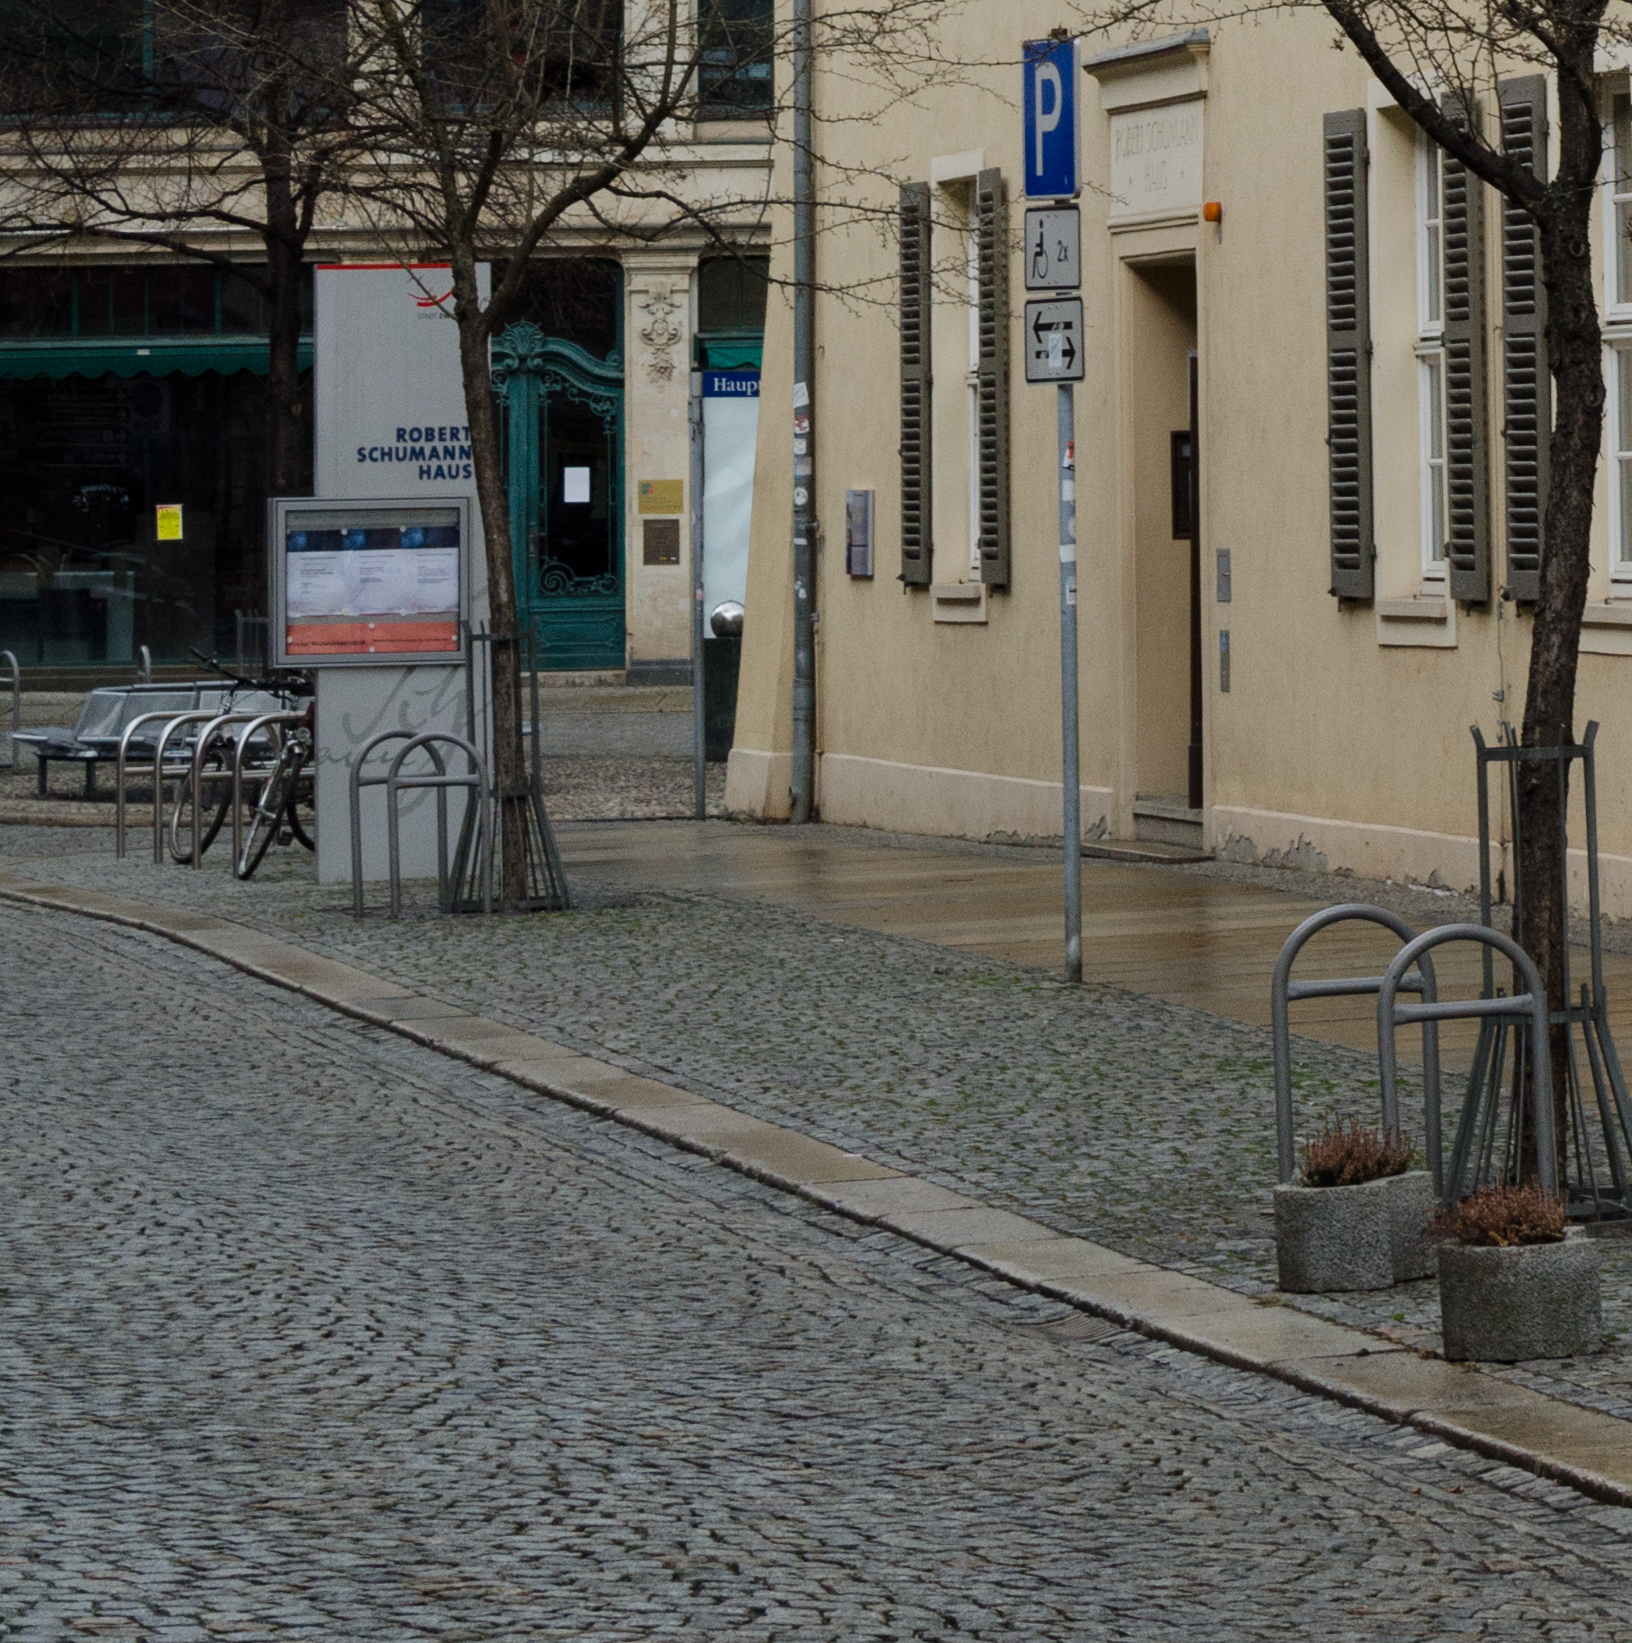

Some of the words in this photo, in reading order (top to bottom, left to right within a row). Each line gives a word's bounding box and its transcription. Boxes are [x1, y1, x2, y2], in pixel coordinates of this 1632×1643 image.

[1035, 62, 1062, 176] P
[1056, 239, 1069, 264] 2x
[396, 426, 471, 443] ROBERT
[357, 445, 473, 463] SCHUMANN
[418, 463, 472, 480] HAUS
